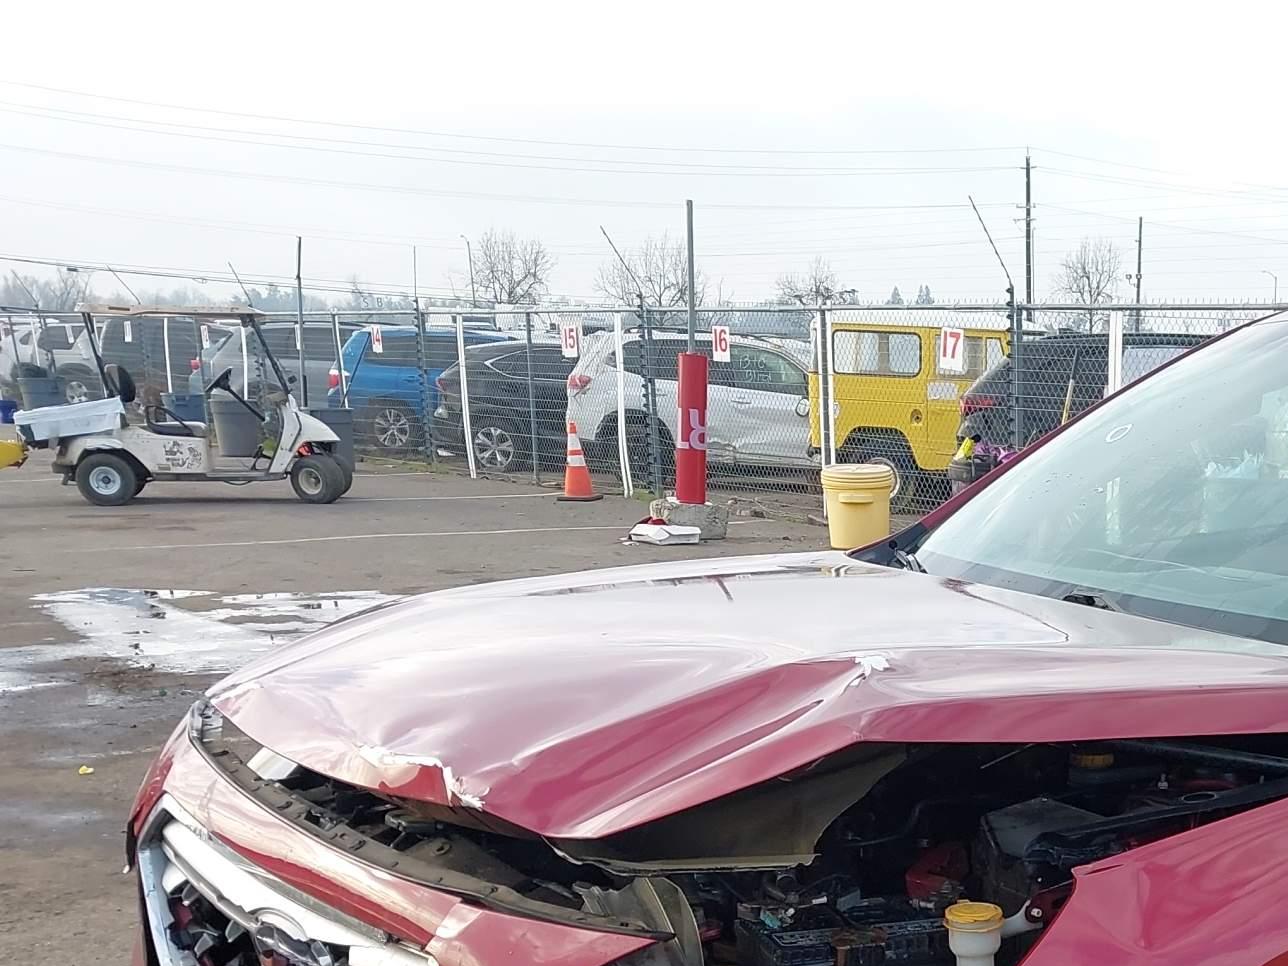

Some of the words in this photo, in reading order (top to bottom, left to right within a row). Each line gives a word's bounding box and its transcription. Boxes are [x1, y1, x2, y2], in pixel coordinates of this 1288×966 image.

[371, 327, 381, 346] 14
[564, 327, 576, 349] 15
[713, 328, 728, 353] 16
[942, 330, 962, 359] 17
